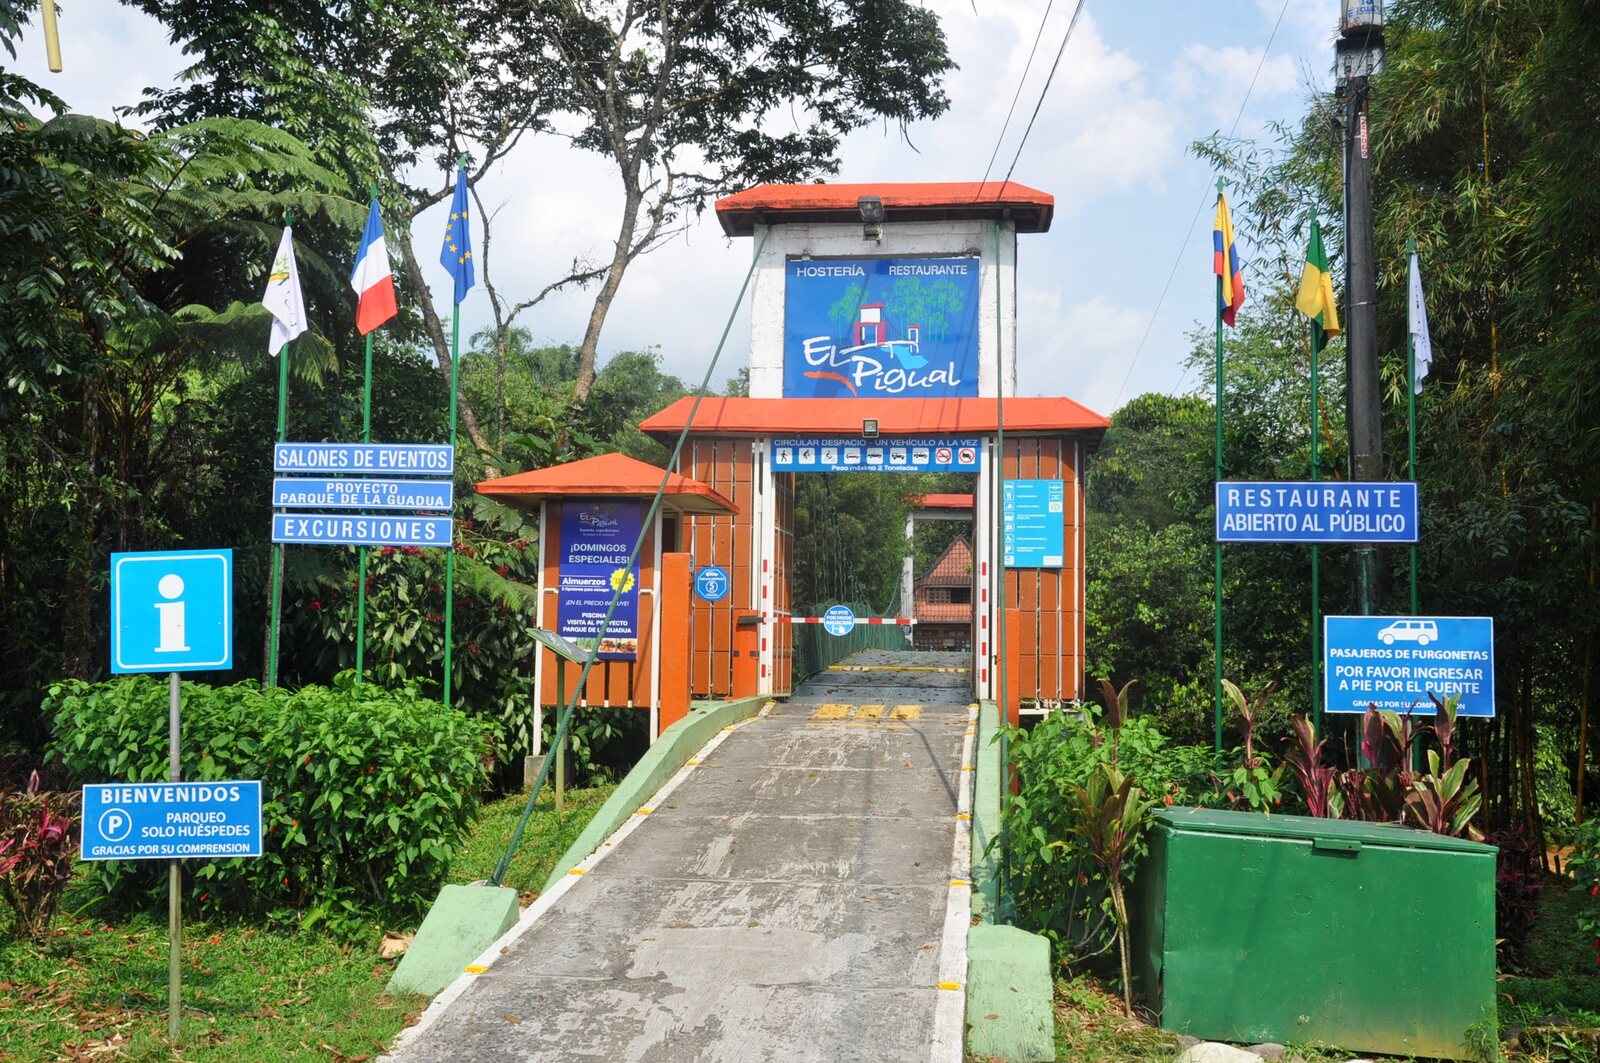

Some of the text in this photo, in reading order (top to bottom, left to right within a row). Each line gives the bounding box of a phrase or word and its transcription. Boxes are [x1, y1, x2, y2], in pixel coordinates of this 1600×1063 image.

[796, 264, 968, 277] HOSTERÍA RESTAURANTE
[851, 355, 961, 394] Pigual
[890, 437, 936, 446] VEHÍCULO
[946, 439, 958, 447] LA
[278, 449, 447, 468] SALONES DE EVENTOS
[326, 483, 398, 494] PROYECTO
[280, 493, 444, 506] PARQUE DE LA GUADUA
[1228, 489, 1401, 508] RESTAURANTE
[1223, 510, 1406, 533] ABIERTO AL PÚBLICO
[284, 519, 436, 540] EXCURSIONES
[570, 543, 627, 553] ¡DOMINGOS
[569, 555, 630, 564] ESPECIALES!
[562, 577, 606, 586] Almuerzos
[1330, 648, 1488, 660] PASAJEROS DE FURGONETAS
[1335, 665, 1483, 680] POR FAVOR INGRESAR
[1339, 680, 1480, 694] A PIE POR EL PUENTE
[1385, 700, 1399, 708] POR
[1401, 701, 1411, 709] SU
[101, 786, 240, 804] BIENVENIDOS
[108, 815, 123, 835] P
[166, 811, 226, 825] PARQUEO
[141, 823, 250, 838] SOLO HUÉSPEDES
[91, 843, 250, 855] GRACIAS POR SU COMPRENSION
